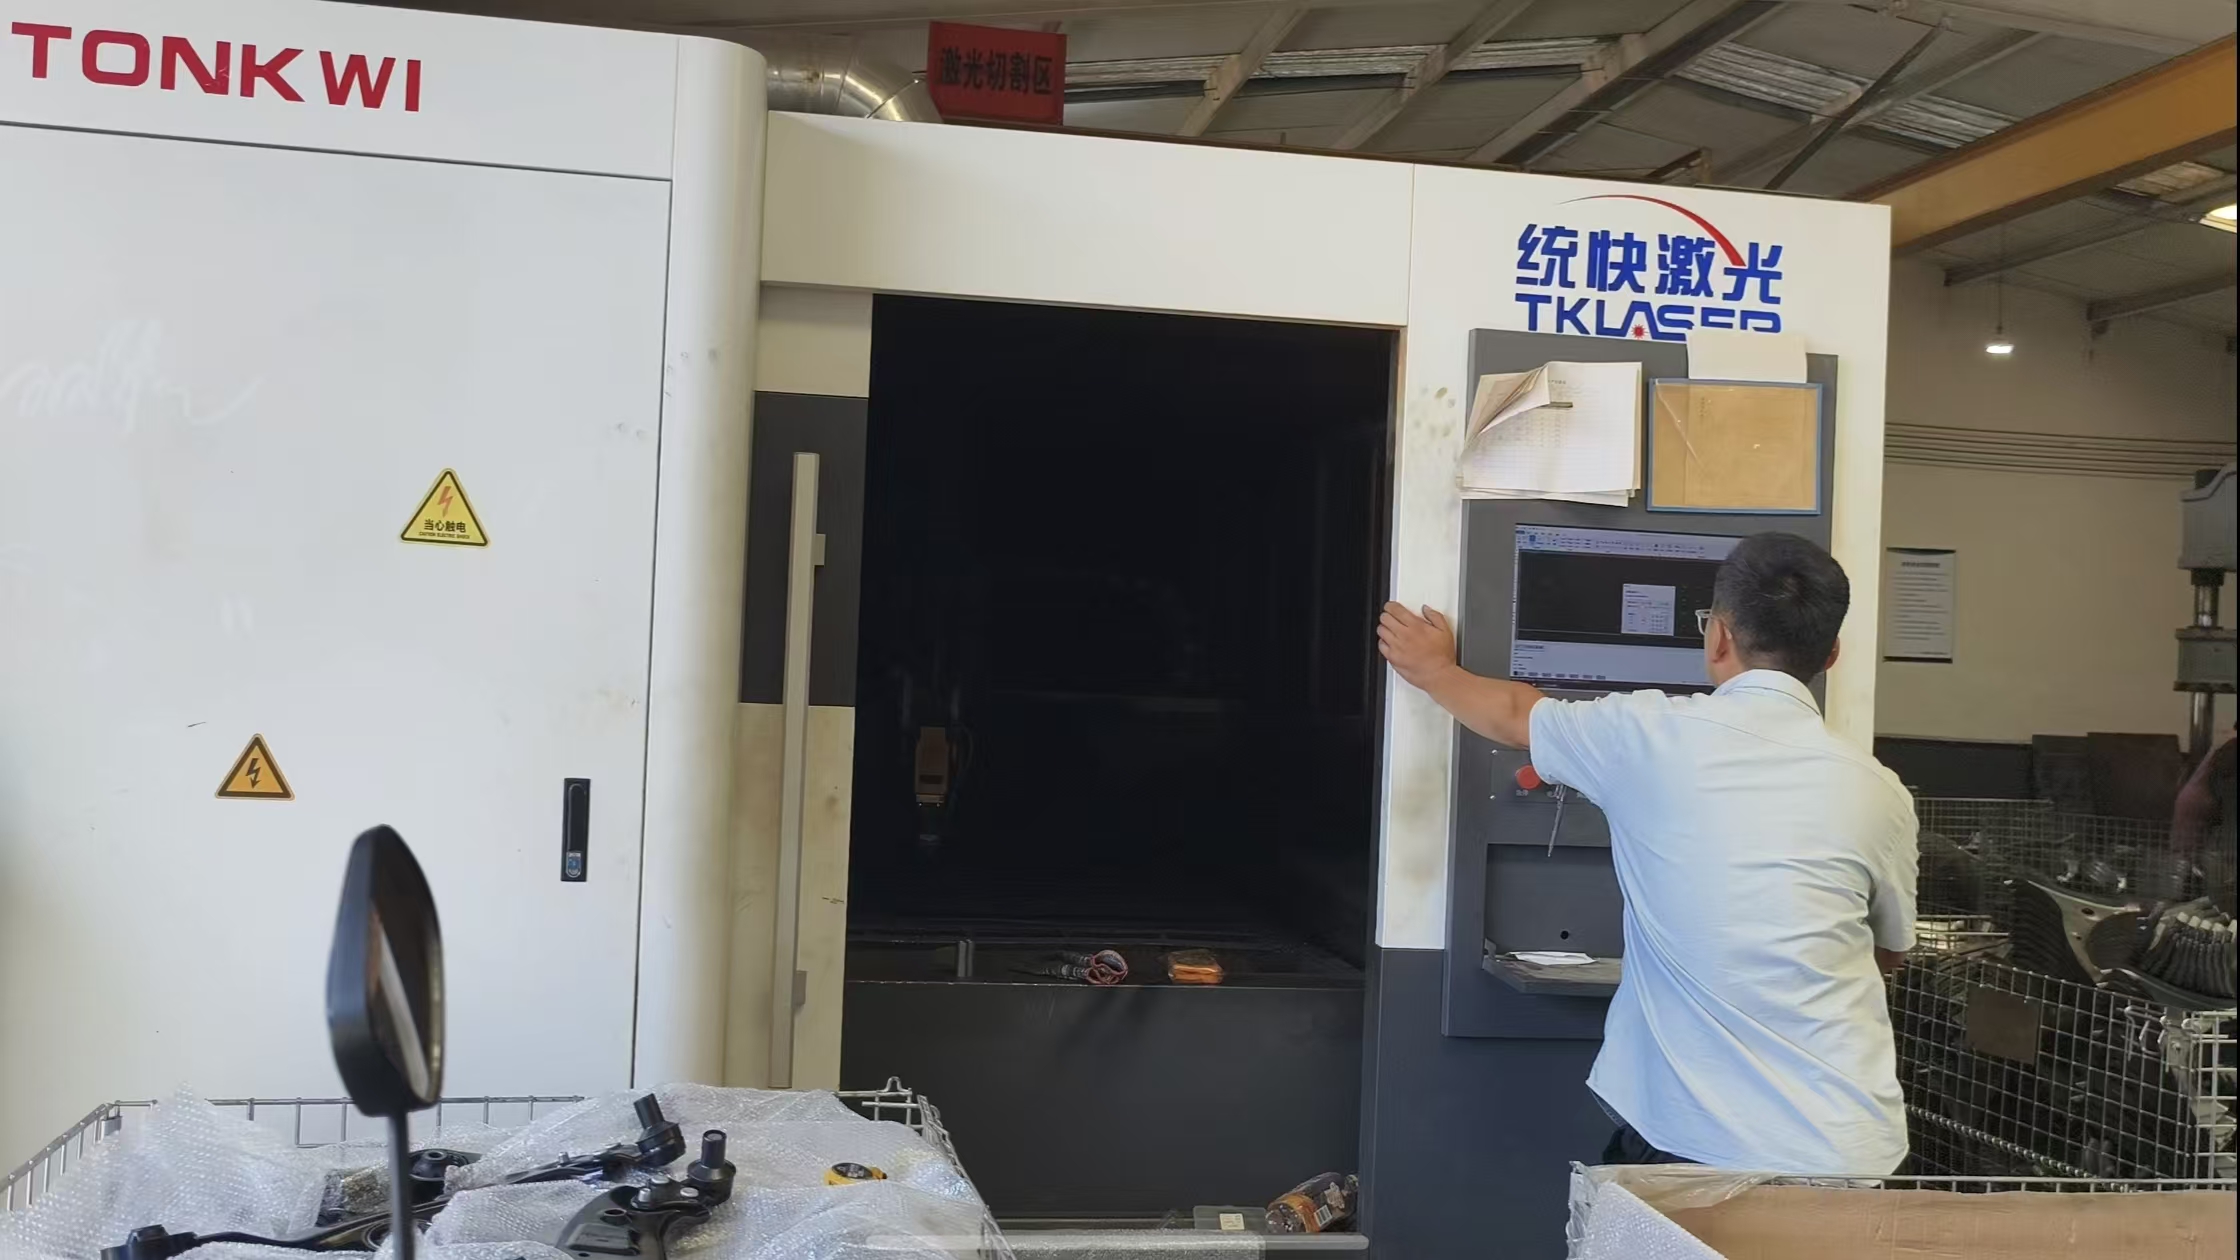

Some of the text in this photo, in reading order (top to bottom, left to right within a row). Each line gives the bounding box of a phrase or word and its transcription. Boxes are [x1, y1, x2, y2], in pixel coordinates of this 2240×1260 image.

[938, 47, 1053, 95] 激光切割区
[1515, 223, 1783, 305] 统快激光
[423, 518, 466, 533] 当心触电
